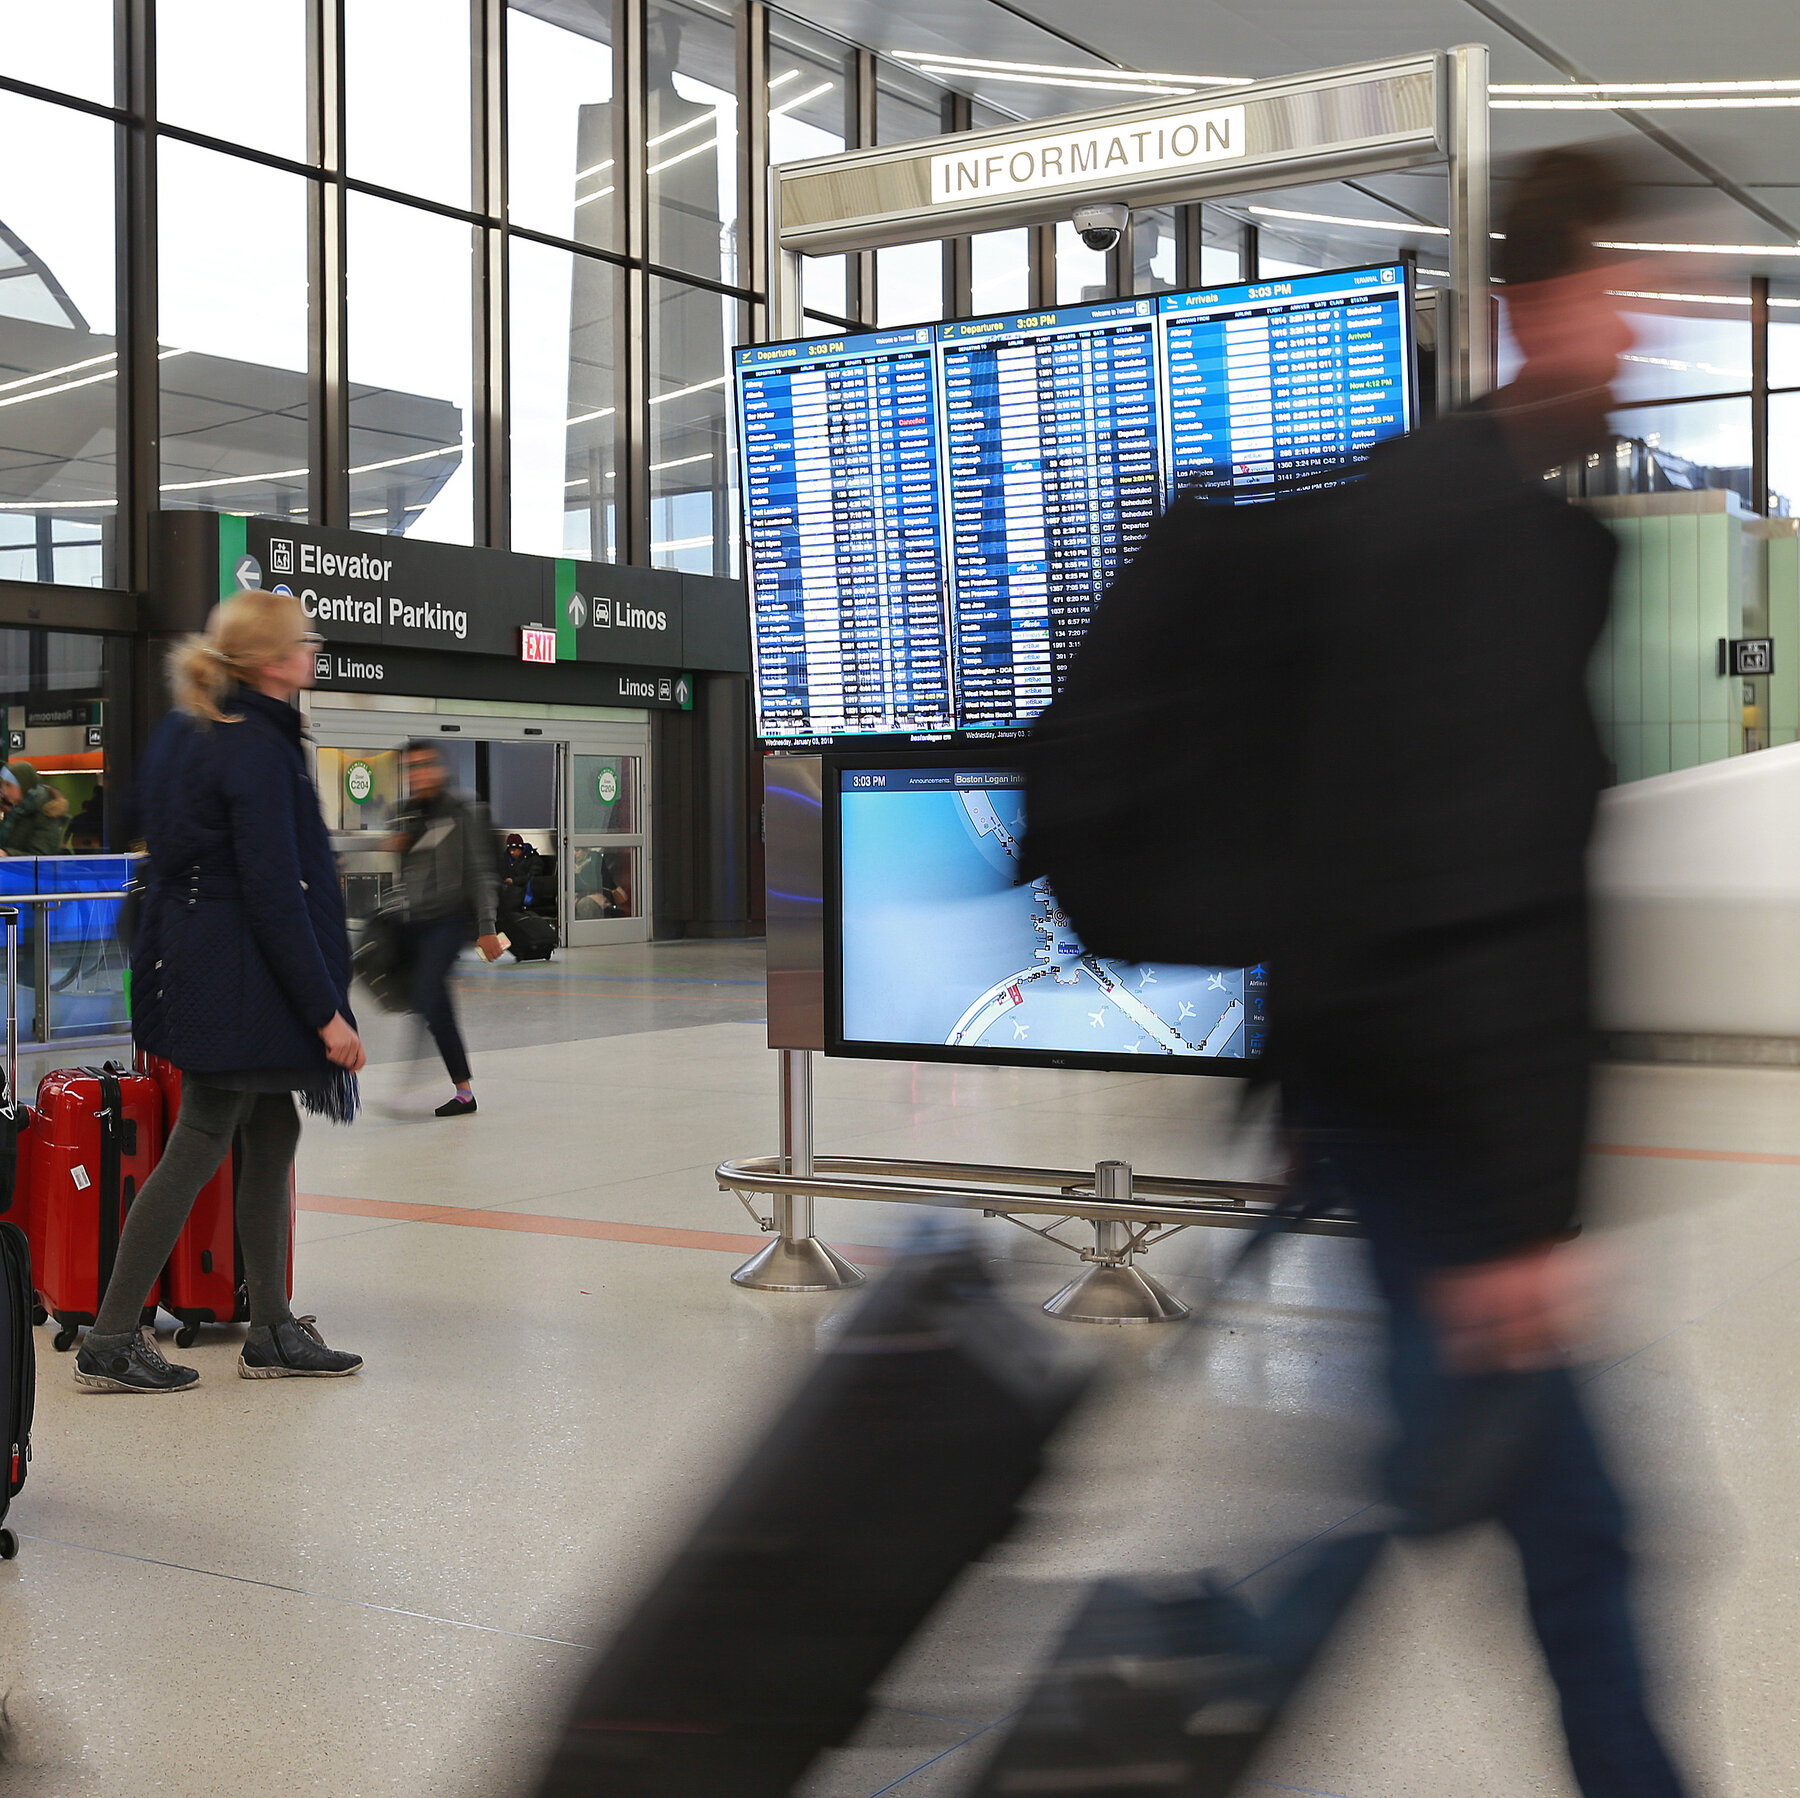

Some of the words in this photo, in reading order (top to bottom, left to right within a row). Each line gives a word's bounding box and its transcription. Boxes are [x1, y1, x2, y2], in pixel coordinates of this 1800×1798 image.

[946, 119, 1229, 193] INFORMATION
[1186, 294, 1219, 306] Arrivals
[1248, 287, 1271, 299] 3:03
[1274, 284, 1291, 295] PM
[1354, 276, 1378, 284] TERMINAL
[960, 323, 1004, 335] Departures
[1017, 317, 1037, 328] 3:03
[1040, 314, 1055, 325] PM
[1348, 331, 1372, 341] Arrived
[758, 349, 796, 360] Departures
[809, 345, 827, 355] 3:03
[830, 342, 843, 352] PM
[1365, 380, 1380, 388] 4:12
[898, 418, 926, 426] Cancelled
[1383, 415, 1394, 423] PM
[1351, 429, 1376, 438] Arrived
[1189, 457, 1214, 465] Angeles
[1121, 487, 1151, 495] Scheduled
[300, 544, 392, 581] Elevator
[300, 589, 382, 624] Central
[389, 598, 467, 639] Parking
[616, 602, 666, 631] Limos
[527, 633, 553, 661] EXIT
[338, 658, 383, 679] Limos
[619, 678, 655, 697] Limos
[351, 781, 368, 789] C204
[853, 776, 870, 787] 3:03
[873, 775, 886, 786] PM
[909, 777, 951, 785] Announcements:
[985, 776, 1008, 785] Logan
